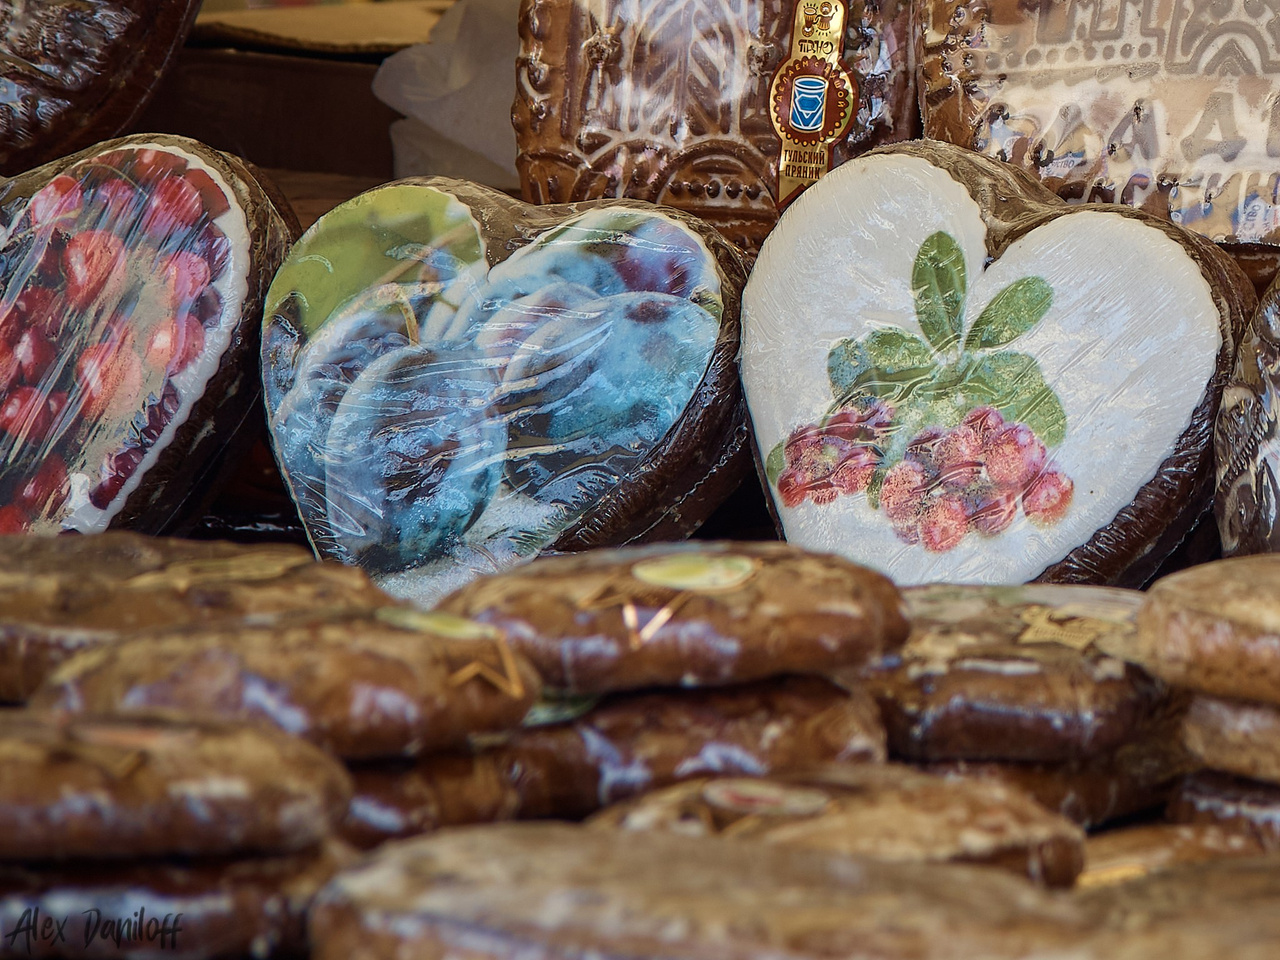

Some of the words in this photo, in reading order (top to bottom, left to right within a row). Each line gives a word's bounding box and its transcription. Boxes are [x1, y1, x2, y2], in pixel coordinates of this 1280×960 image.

[776, 60, 810, 103] ДЕЛАЕМ
[783, 149, 826, 166] ТУЛЬСКИЙ
[784, 165, 821, 180] ПРЯНИК
